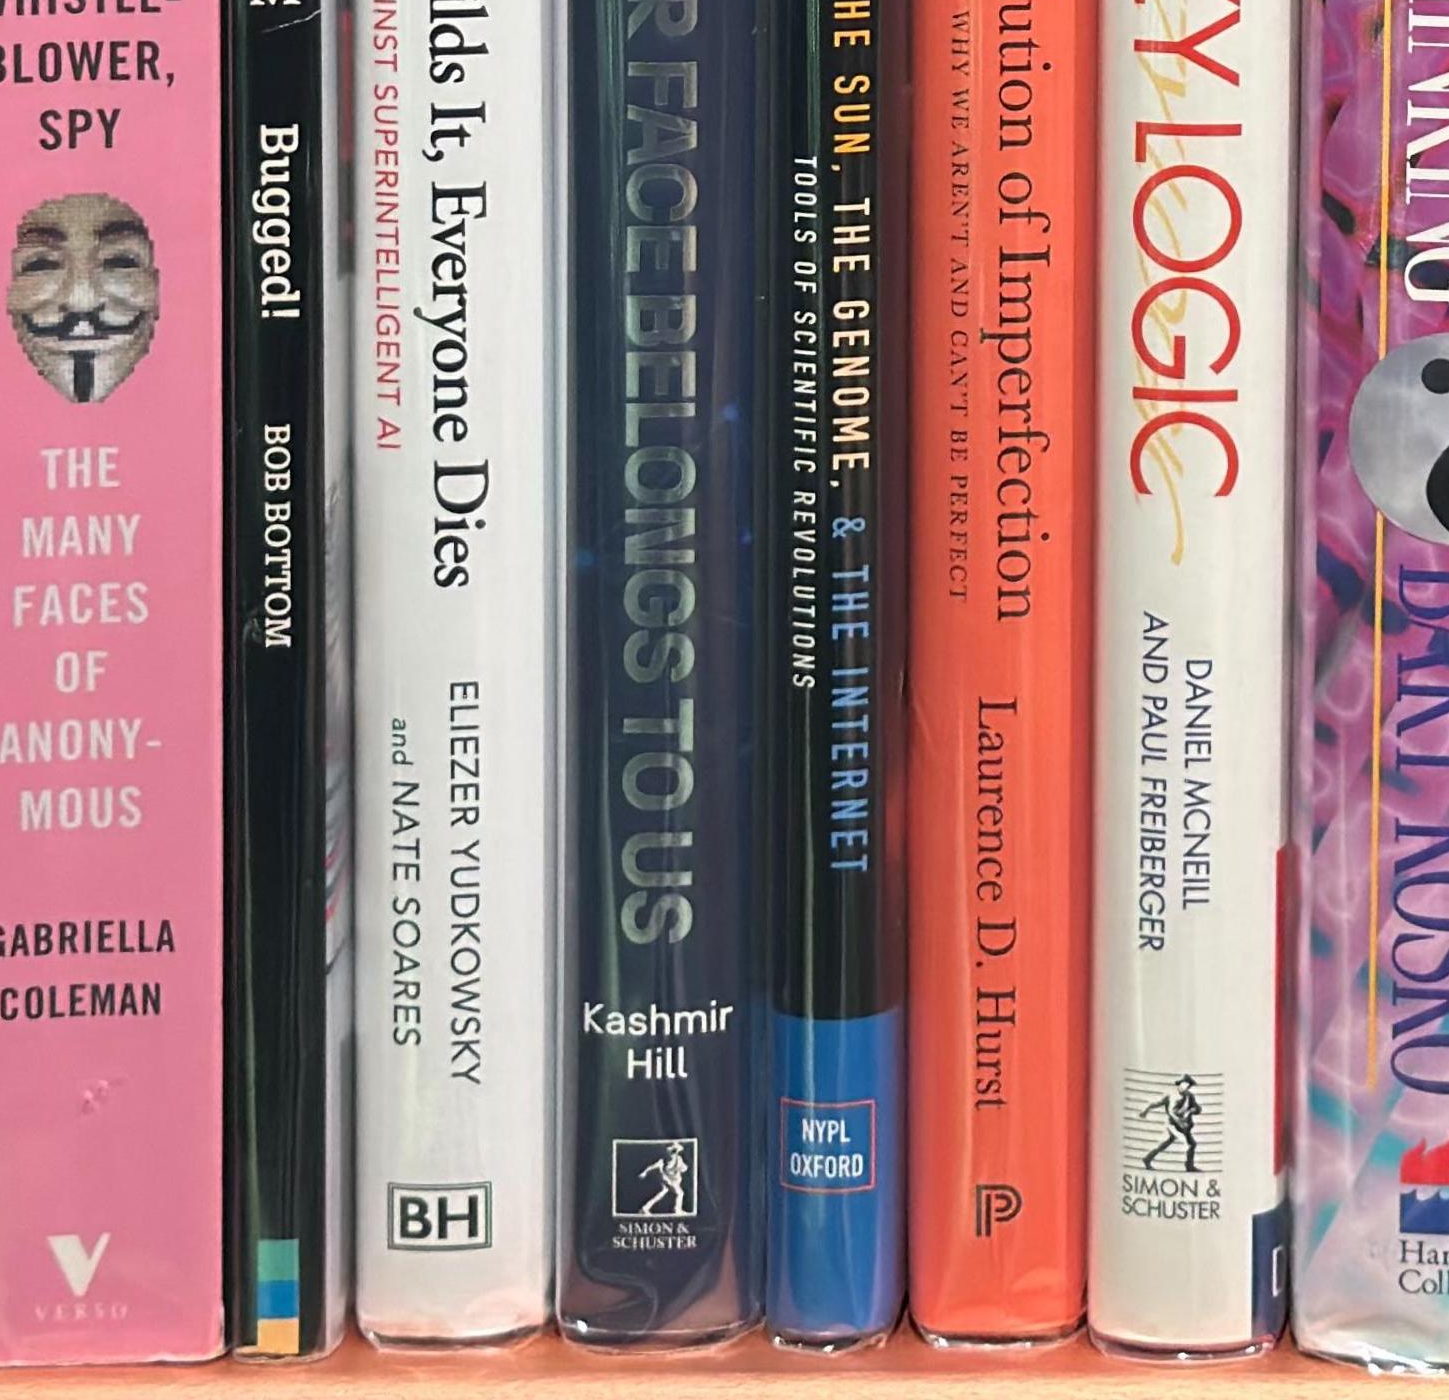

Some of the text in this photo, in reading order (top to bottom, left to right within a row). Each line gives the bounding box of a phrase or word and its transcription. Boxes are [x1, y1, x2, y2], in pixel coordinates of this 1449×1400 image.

[951, 11, 969, 71] WHY
[39, 109, 121, 151] SPY
[422, 102, 485, 161] It,
[951, 89, 969, 129] WE
[252, 124, 300, 317] Bugged!
[951, 141, 969, 241] AREN'T
[998, 172, 1051, 233] of
[374, 84, 400, 406] SUPERINTELLIGENT
[951, 258, 969, 317] AND
[414, 182, 486, 441] Everyone
[1130, 122, 1242, 496] LOGIC
[950, 331, 968, 416] CAN'T
[377, 417, 401, 448] AI
[793, 156, 817, 688] TOOLS OF SCIENTIFIC REVOLUTIONS
[950, 430, 968, 462] BE
[980, 245, 1050, 621] Imperfection
[264, 424, 291, 648] BOB BOTTOM
[434, 460, 489, 587] Dies
[949, 475, 968, 603] PERFECT
[1139, 611, 1168, 951] AND PAUL FREIBERGER
[1183, 660, 1212, 910] DANIEL MCNEILL
[392, 718, 421, 1045] and NATE SOARES
[450, 682, 480, 1084] ELIEZER YUDKOWSKY
[975, 697, 1017, 1110] Laurence D. Hurst
[0, 983, 162, 1021] COLEMAN
[583, 1000, 734, 1036] Kashmir
[627, 1047, 688, 1080] Hill
[790, 1152, 864, 1179] OXFORD
[802, 1118, 851, 1143] NYPL
[399, 1195, 479, 1239] BH
